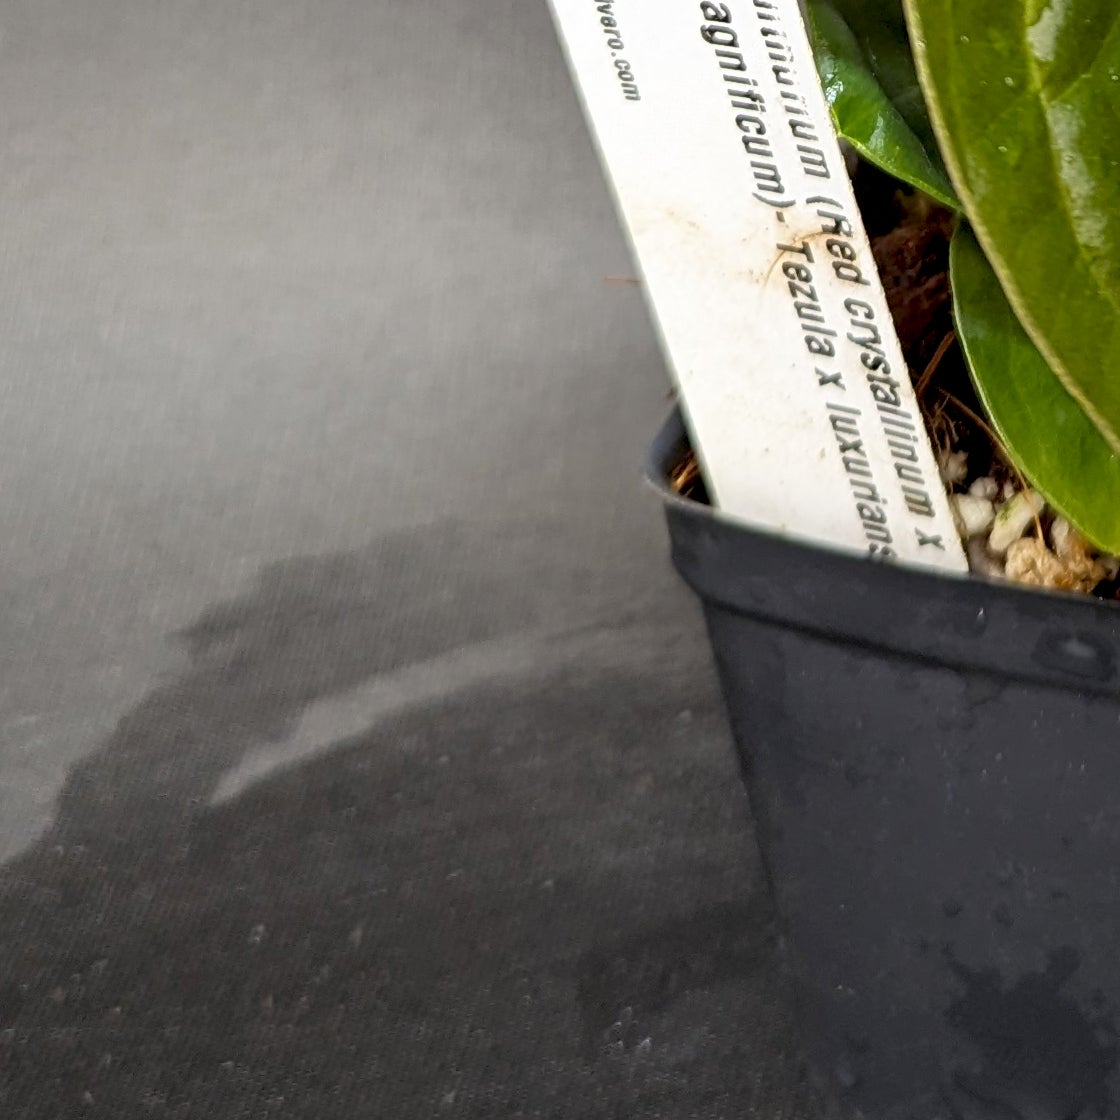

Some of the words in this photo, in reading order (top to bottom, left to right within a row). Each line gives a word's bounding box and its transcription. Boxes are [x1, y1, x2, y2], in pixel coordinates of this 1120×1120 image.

[775, 240, 837, 358] Tezula
[805, 194, 871, 286] (Red
[844, 297, 937, 519] crystallinum
[914, 527, 946, 551] x
[814, 366, 847, 391] x
[825, 401, 900, 560] luxurians
